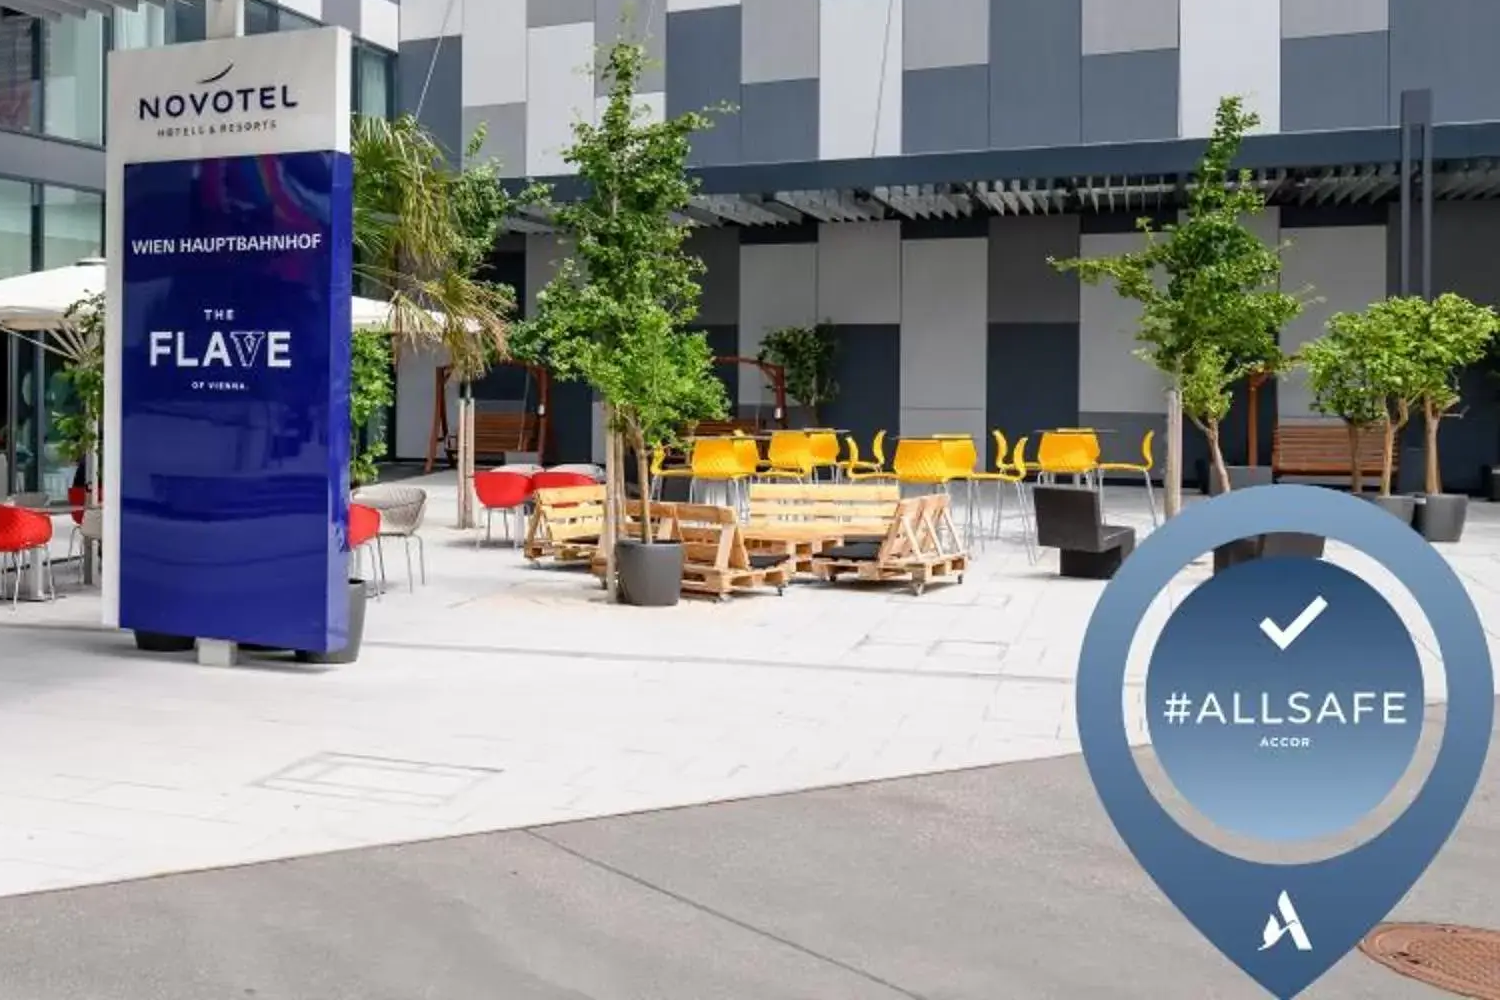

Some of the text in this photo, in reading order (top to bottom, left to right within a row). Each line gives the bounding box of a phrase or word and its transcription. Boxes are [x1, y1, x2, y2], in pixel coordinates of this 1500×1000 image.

[139, 85, 298, 120] NOVOTEL
[157, 126, 206, 137] HOTELS
[219, 120, 277, 134] RESORTS
[132, 233, 322, 254] WIEN HAUPTBAHNHOF
[204, 309, 235, 321] THE
[150, 331, 291, 367] FLAVE
